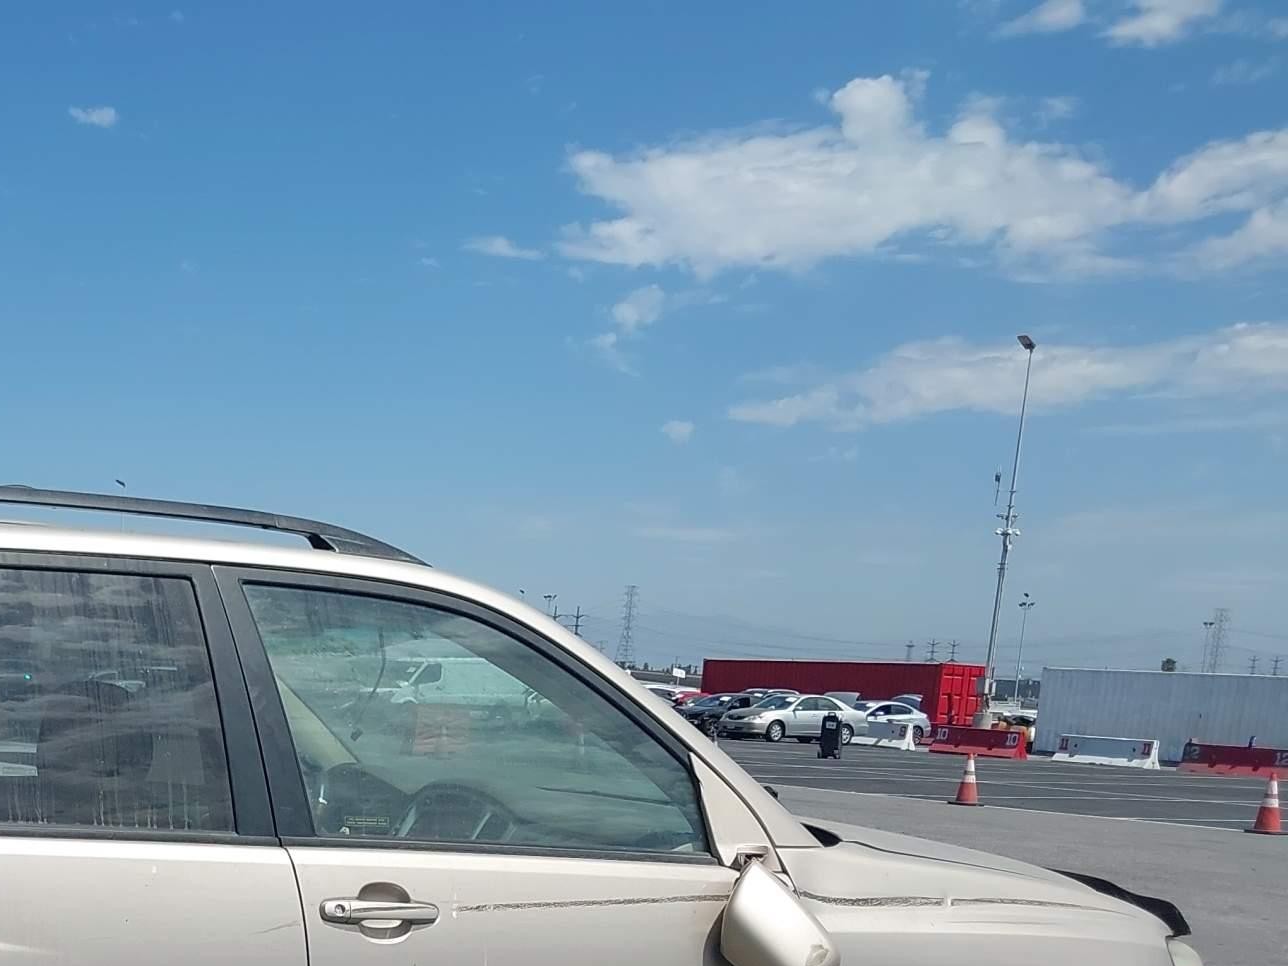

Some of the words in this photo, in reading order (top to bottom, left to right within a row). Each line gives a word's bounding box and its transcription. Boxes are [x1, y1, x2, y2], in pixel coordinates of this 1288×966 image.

[936, 728, 949, 740] 10
[1006, 733, 1018, 746] 10
[1059, 738, 1069, 750] 11
[1142, 743, 1151, 755] 11
